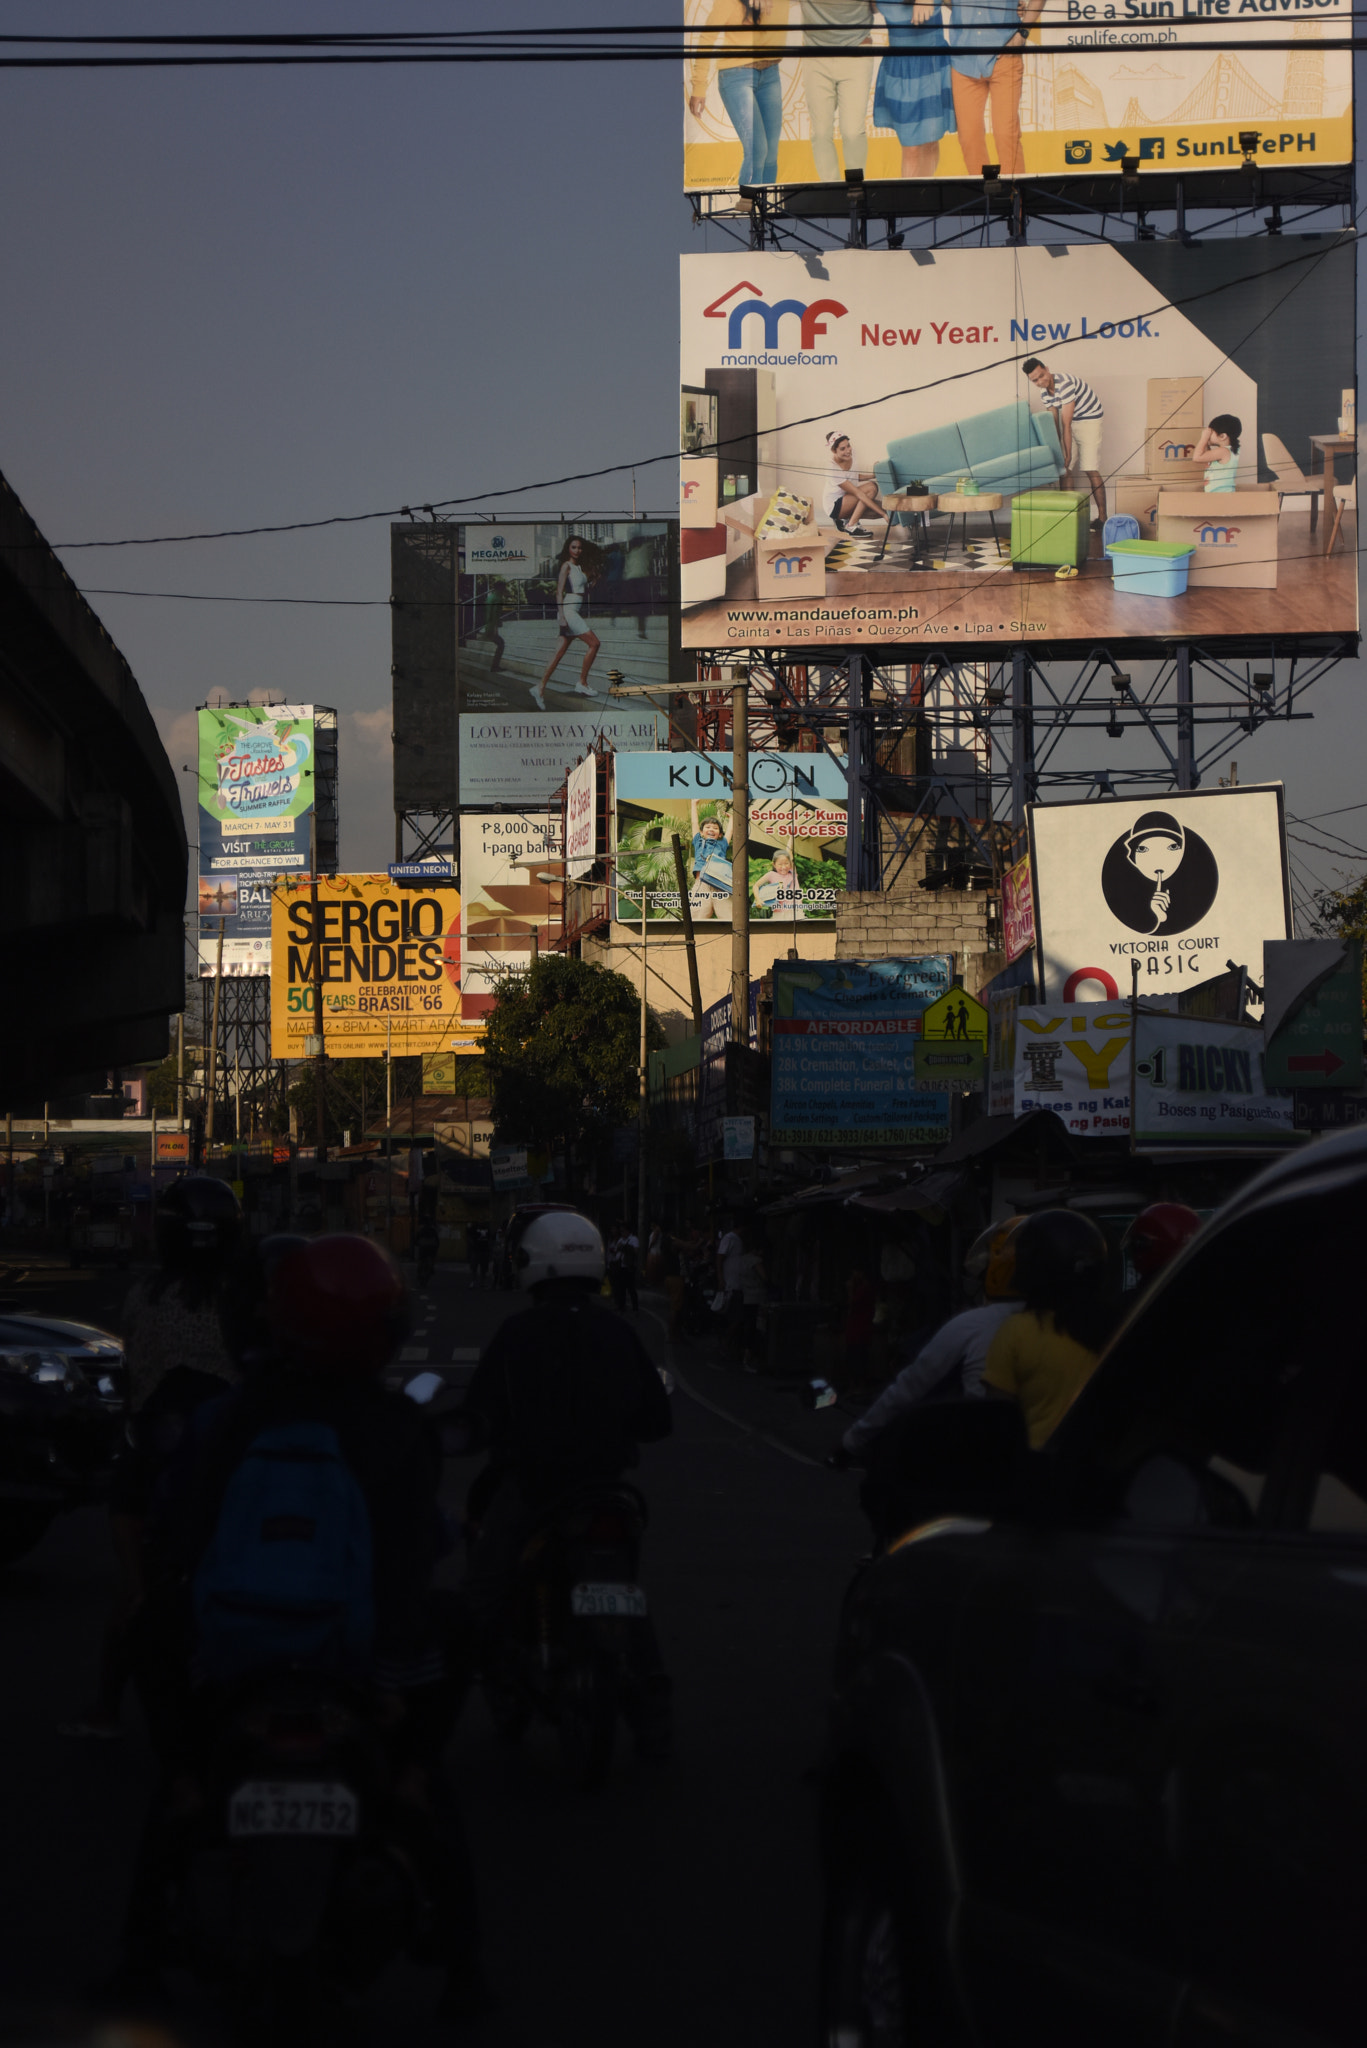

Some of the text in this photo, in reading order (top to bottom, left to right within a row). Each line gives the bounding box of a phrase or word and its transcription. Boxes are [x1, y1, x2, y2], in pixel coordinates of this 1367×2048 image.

[1067, 1, 1097, 20] Be
[1104, 6, 1116, 19] a
[1125, 0, 1174, 18] Sun
[1183, 0, 1231, 16] Life
[1067, 28, 1178, 46] sunlife.com.ph
[1177, 133, 1316, 156] SunLfePH
[861, 314, 1160, 347] New Year. New Look.
[721, 352, 838, 366] mandauefoam
[471, 550, 526, 559] MEGAMALL
[727, 605, 919, 623] www.mandauefoam.ph
[727, 620, 1047, 638] Cainta Las Piñas Quezon Ave Lipa Shaw
[470, 724, 513, 739] LOVE
[514, 724, 548, 738] THE
[550, 724, 585, 738] WAY
[588, 723, 624, 737] YOU
[228, 754, 285, 782] Tastes
[521, 758, 556, 766] MARCH
[228, 776, 293, 809] Travels
[240, 798, 291, 812] SUMMER RAFFLE
[751, 809, 799, 821] School
[224, 821, 291, 831] MARCH MAY 31
[532, 824, 556, 837] ang
[780, 824, 847, 837] SUCCESS
[222, 840, 295, 854] VISIT THE GROVE
[483, 841, 523, 857] I-pang
[215, 859, 231, 867] FOR
[240, 858, 271, 866] CHANCE
[390, 865, 421, 875] UNITED
[423, 865, 449, 874] NEON
[712, 891, 728, 899] age
[288, 898, 443, 945] SERGIO
[1109, 936, 1220, 955] VICTORIA COURT
[287, 942, 443, 983] MENDES
[1131, 954, 1199, 975] PASIG
[868, 969, 946, 989] Evergreen
[359, 984, 443, 996] CELEBRATION OF
[889, 987, 946, 1001] Crematory
[287, 987, 316, 1012] 50
[359, 996, 414, 1011] BRASIL
[343, 1020, 370, 1032] 8PM
[381, 1019, 425, 1031] SMART
[806, 1019, 917, 1034] AFFORDABLE
[368, 1041, 441, 1049] WWW.TCKETNET.COM.PH
[778, 1038, 865, 1051] 14.9k Cremation
[778, 1056, 900, 1074] 28k Cremation, Casket,
[1178, 1043, 1253, 1095] RICKY
[777, 1077, 797, 1092] 38k
[800, 1077, 851, 1094] Complete
[854, 1076, 894, 1091] Funeral
[896, 1077, 905, 1091] &
[1078, 1100, 1098, 1113] ng
[1158, 1101, 1197, 1117] Boses
[1200, 1104, 1217, 1121] ng
[1220, 1103, 1281, 1121] Pasigueño
[1299, 1103, 1316, 1120] Dr.
[1322, 1103, 1340, 1120] M.
[1070, 1114, 1130, 1130] ng Pasig
[270, 1800, 352, 1830] 32752
